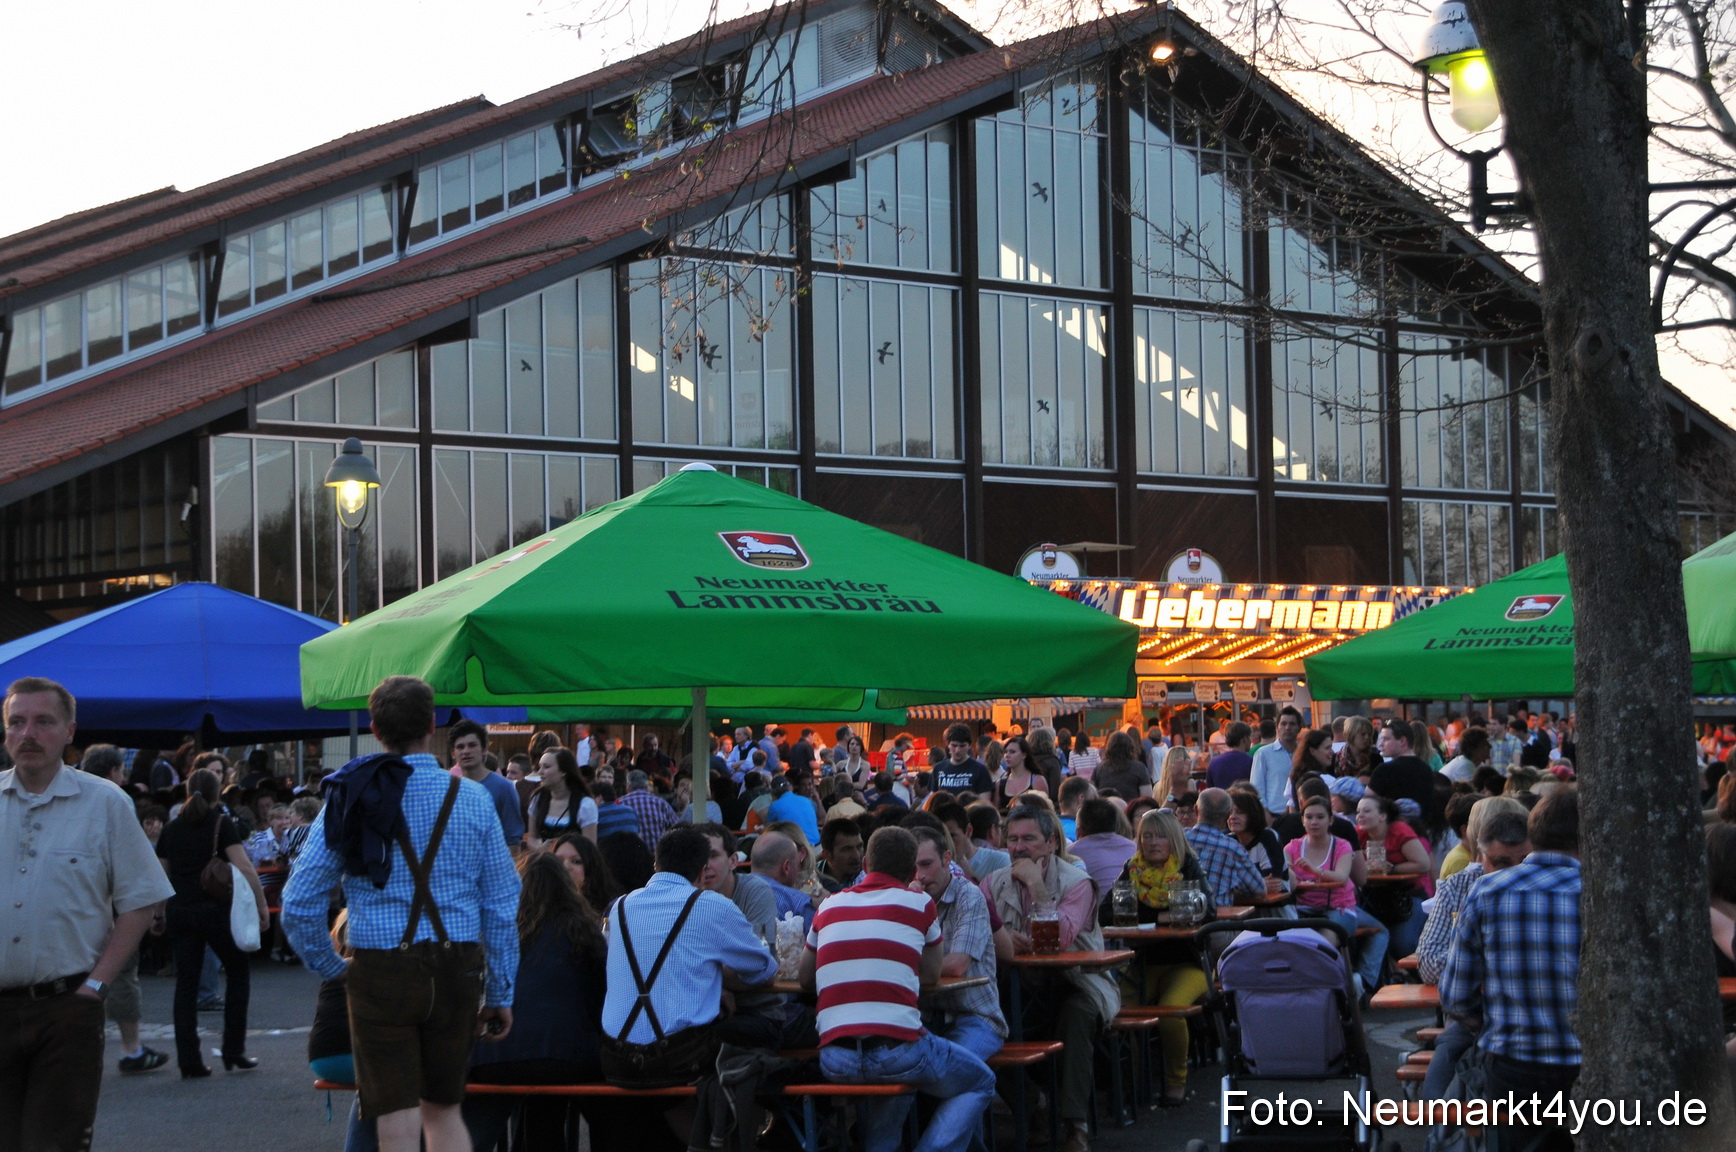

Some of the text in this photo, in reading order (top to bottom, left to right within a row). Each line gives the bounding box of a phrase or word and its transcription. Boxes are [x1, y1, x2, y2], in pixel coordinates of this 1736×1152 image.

[693, 576, 888, 594] Neumarkter
[665, 590, 943, 614] Lammsbräu
[1119, 589, 1394, 629] Liebermann
[1424, 634, 1573, 650] Lammsbrä
